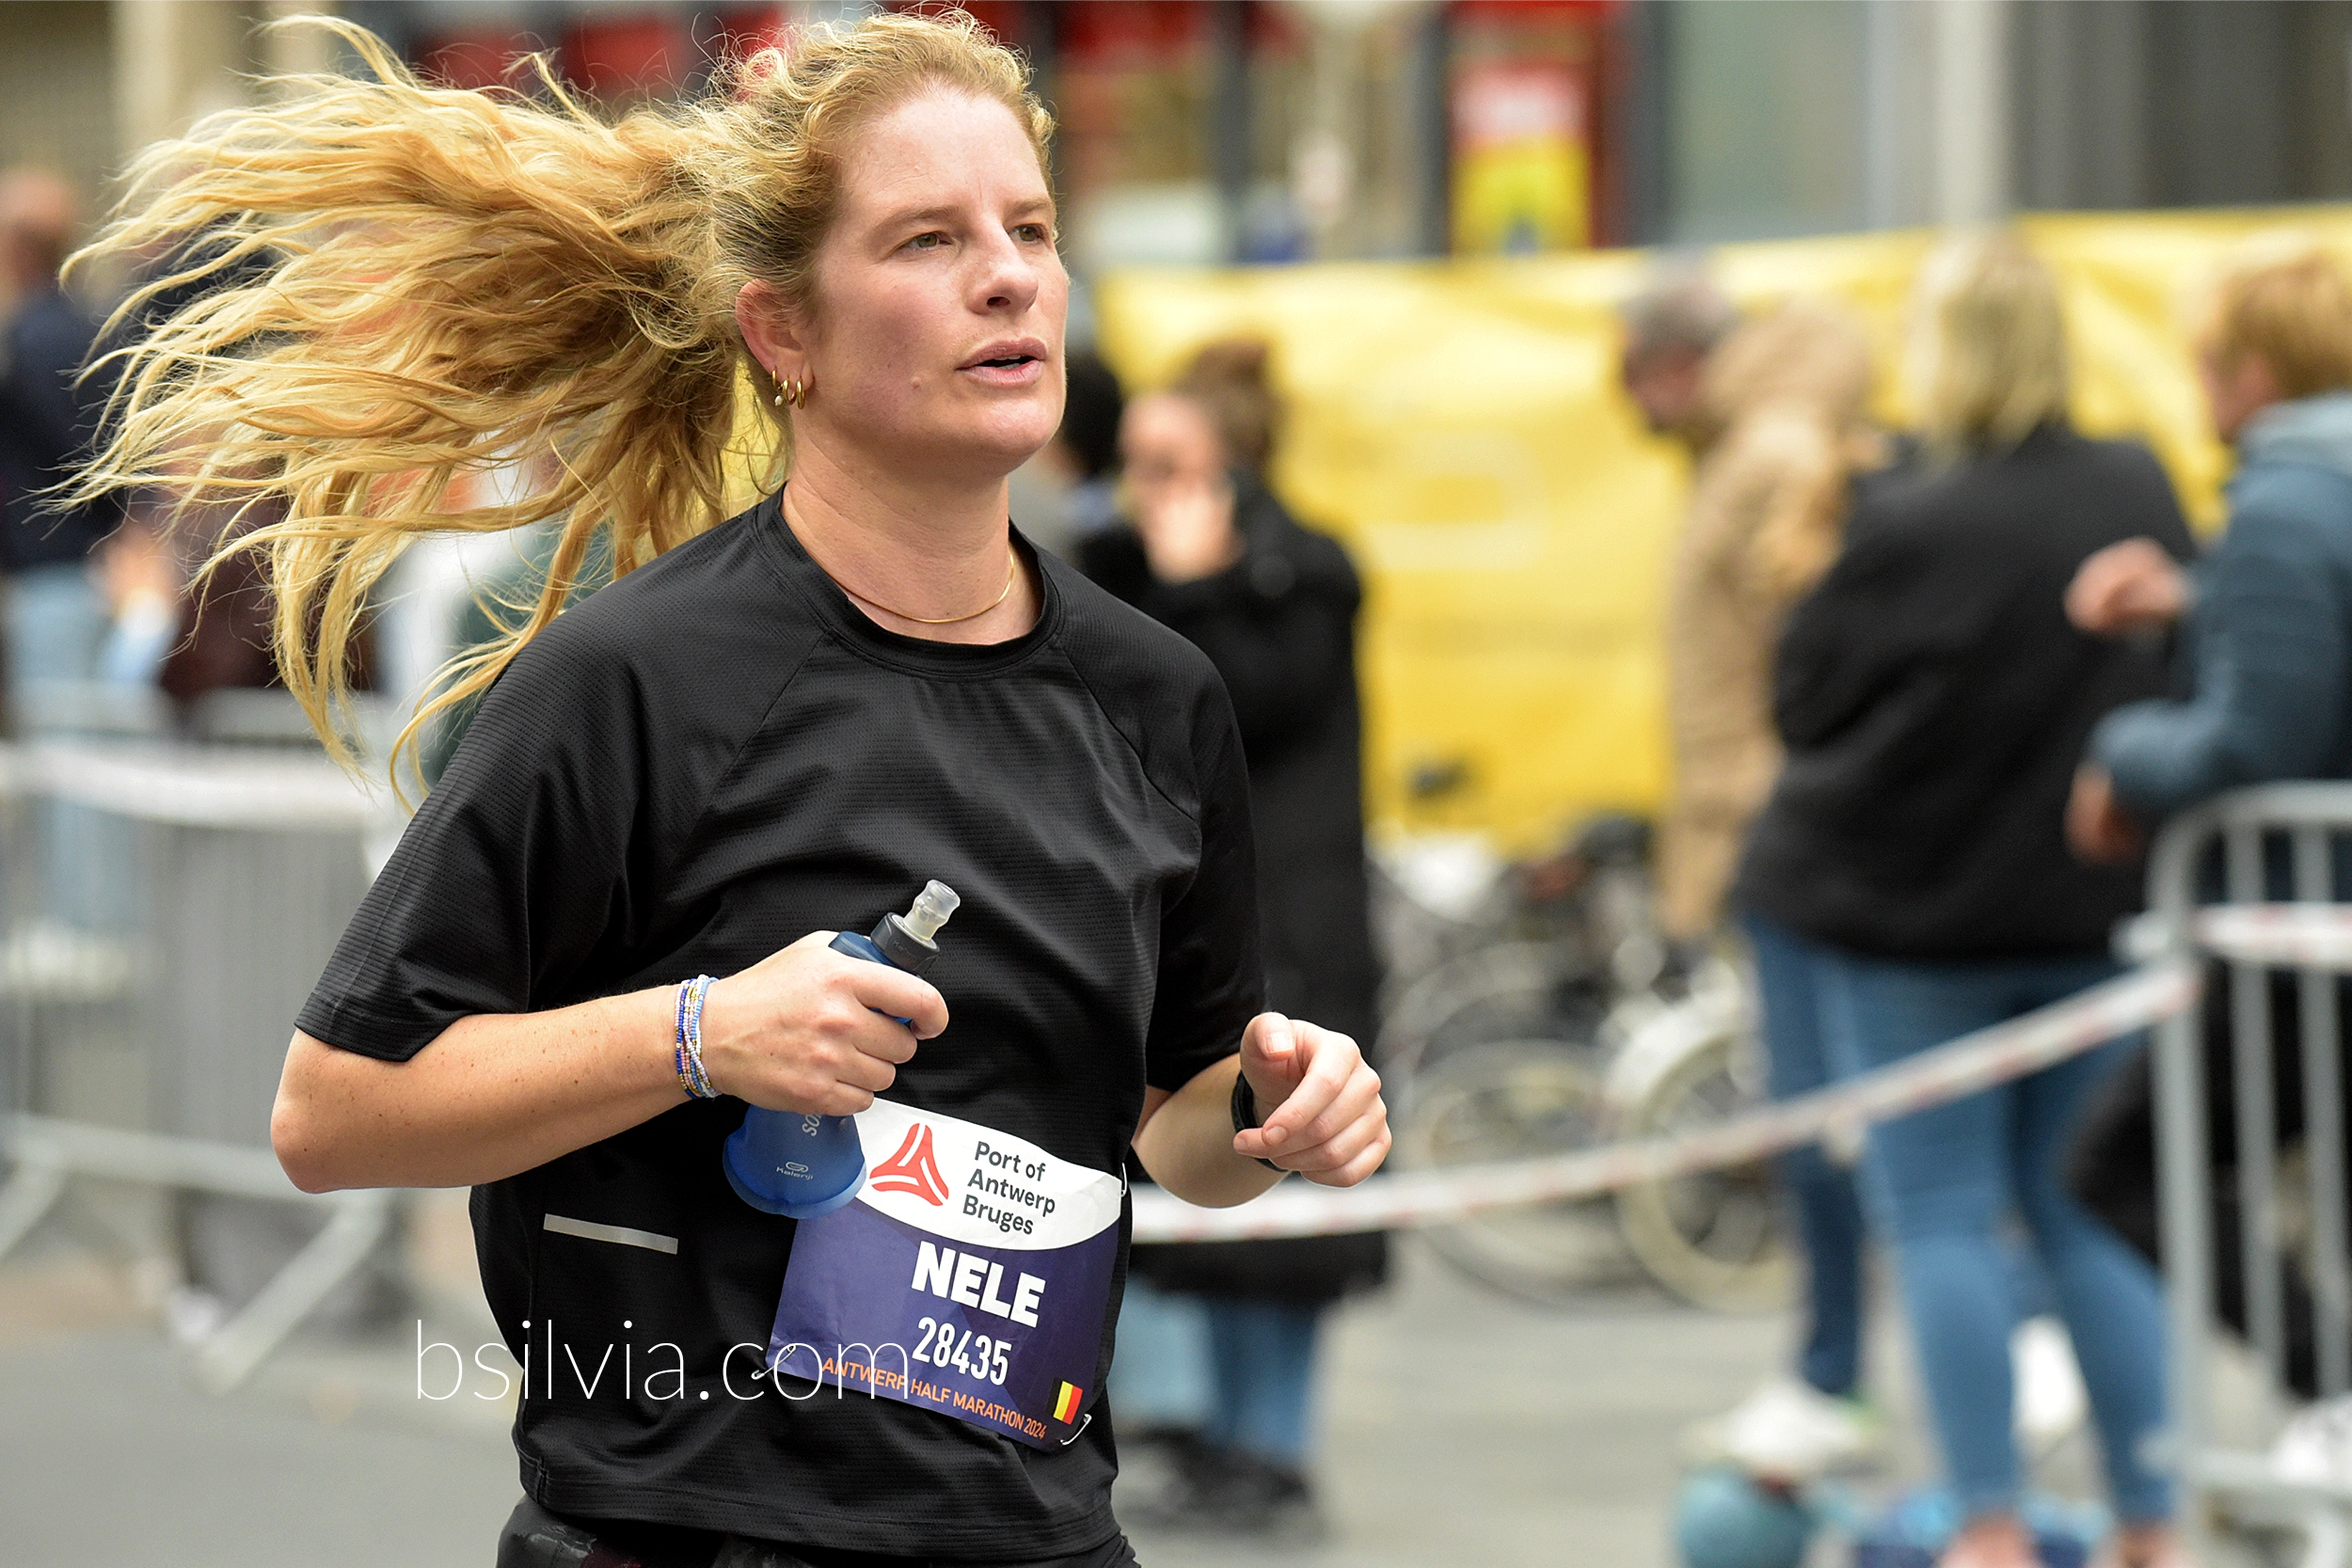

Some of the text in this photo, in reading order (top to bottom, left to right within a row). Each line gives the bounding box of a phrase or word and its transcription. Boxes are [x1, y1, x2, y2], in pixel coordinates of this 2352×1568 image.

[975, 1141, 1046, 1181] Port of
[962, 1194, 1034, 1235] Bruges
[967, 1168, 1056, 1217] Antwerp
[912, 1241, 1046, 1328] NELE
[912, 1317, 1012, 1386] 28435
[822, 1357, 1047, 1440] ANTWERP HALF MARATHON 2024
